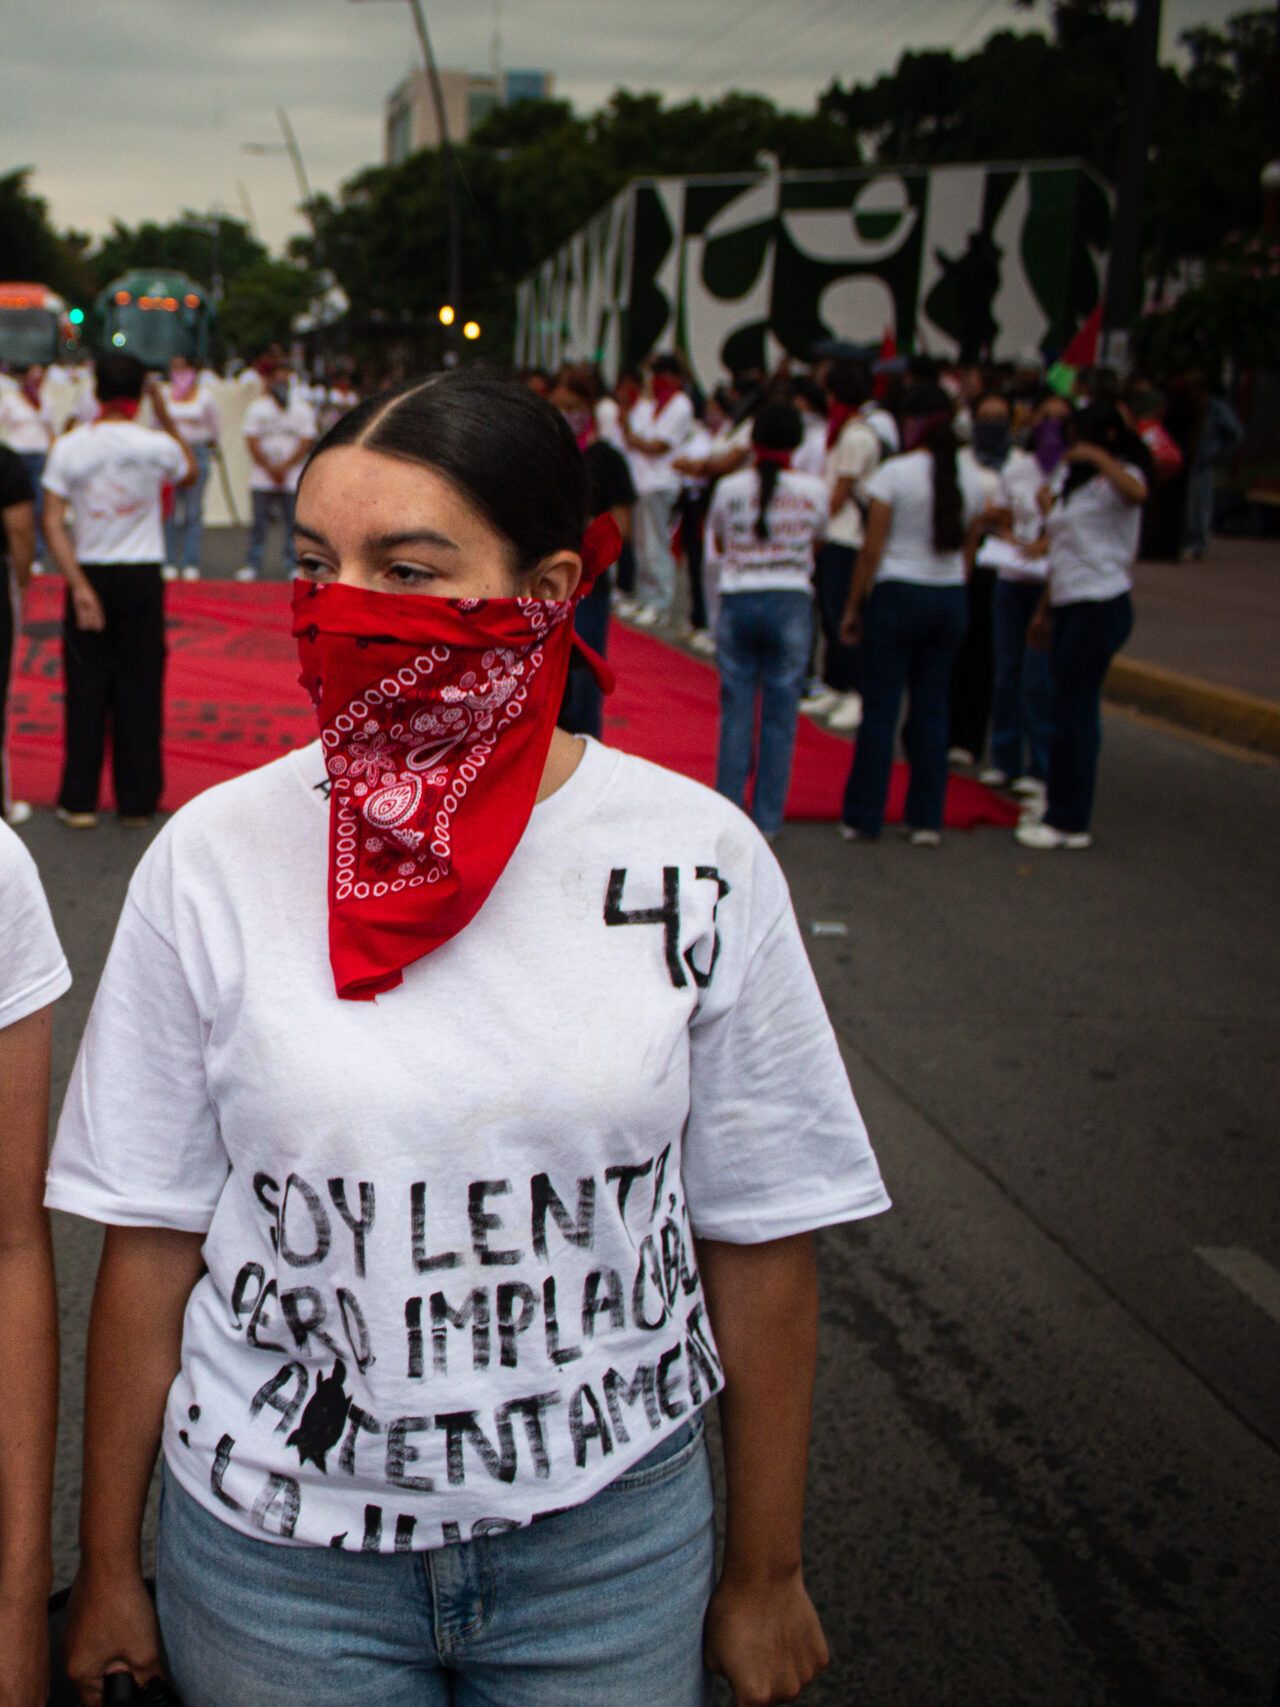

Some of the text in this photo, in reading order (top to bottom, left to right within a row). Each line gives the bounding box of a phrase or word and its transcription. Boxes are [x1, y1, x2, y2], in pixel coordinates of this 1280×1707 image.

[604, 866, 730, 989] 43
[252, 1171, 376, 1280] SOY
[231, 1262, 377, 1376] PERO
